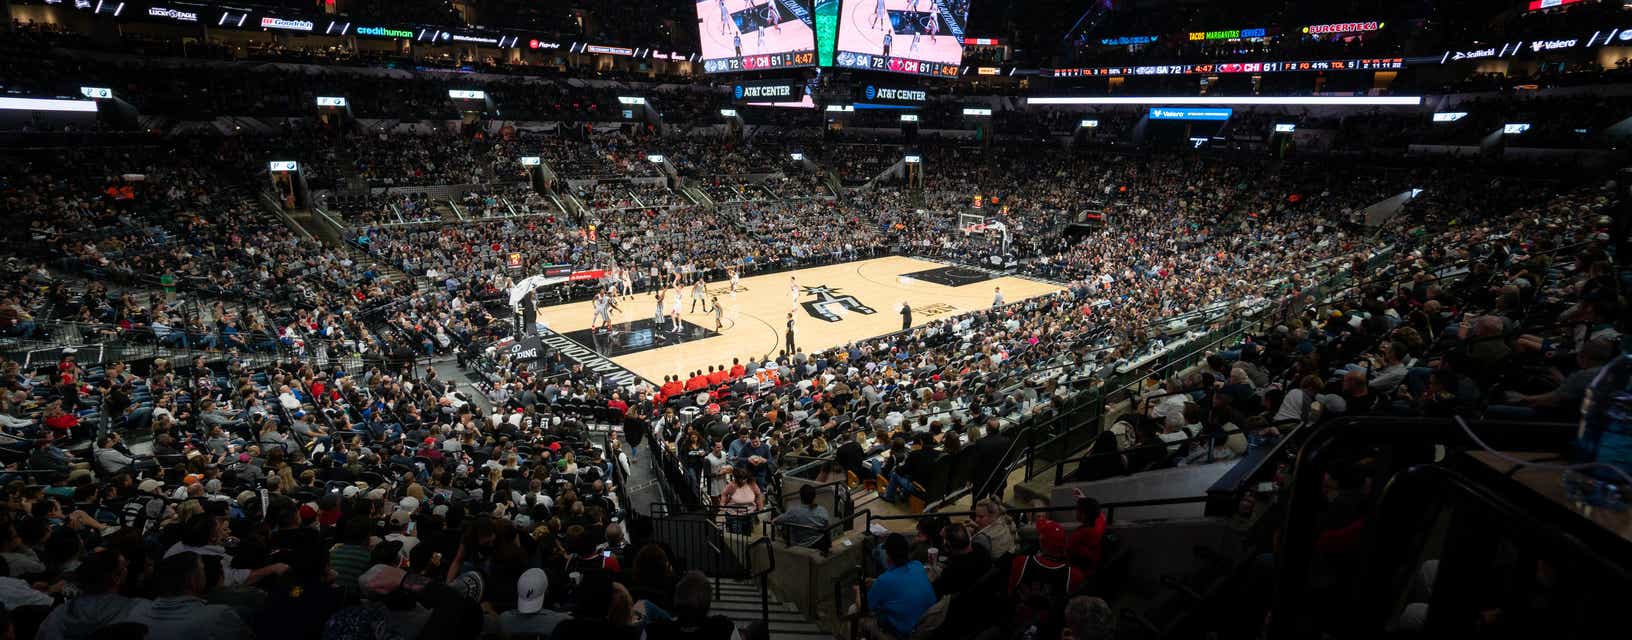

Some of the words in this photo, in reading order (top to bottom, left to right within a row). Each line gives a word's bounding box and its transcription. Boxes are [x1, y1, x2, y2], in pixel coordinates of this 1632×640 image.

[148, 9, 170, 17] LUCKY
[177, 11, 198, 19] EAGLE
[1189, 32, 1205, 41] TACOS
[1206, 30, 1240, 40] MARGARITAS
[1544, 39, 1577, 49] Valero
[717, 60, 726, 69] SA
[729, 59, 739, 69] 72
[756, 55, 769, 67] CHI
[771, 55, 782, 66] 61
[795, 53, 813, 65] 4:47
[856, 56, 868, 66] SA
[872, 57, 884, 68] 72
[904, 61, 918, 72] CHI
[919, 63, 930, 73] 61
[942, 65, 958, 76] 4:47
[1156, 66, 1168, 74] SA
[1170, 65, 1182, 74] 72
[1195, 64, 1213, 73] 4:47
[1244, 63, 1260, 72] CHI
[1263, 63, 1277, 72] 61
[1331, 61, 1344, 69] TOL
[743, 86, 762, 97] AT&T
[761, 85, 791, 97] CENTER
[877, 88, 896, 99] AT&T
[896, 89, 927, 101] CENTER
